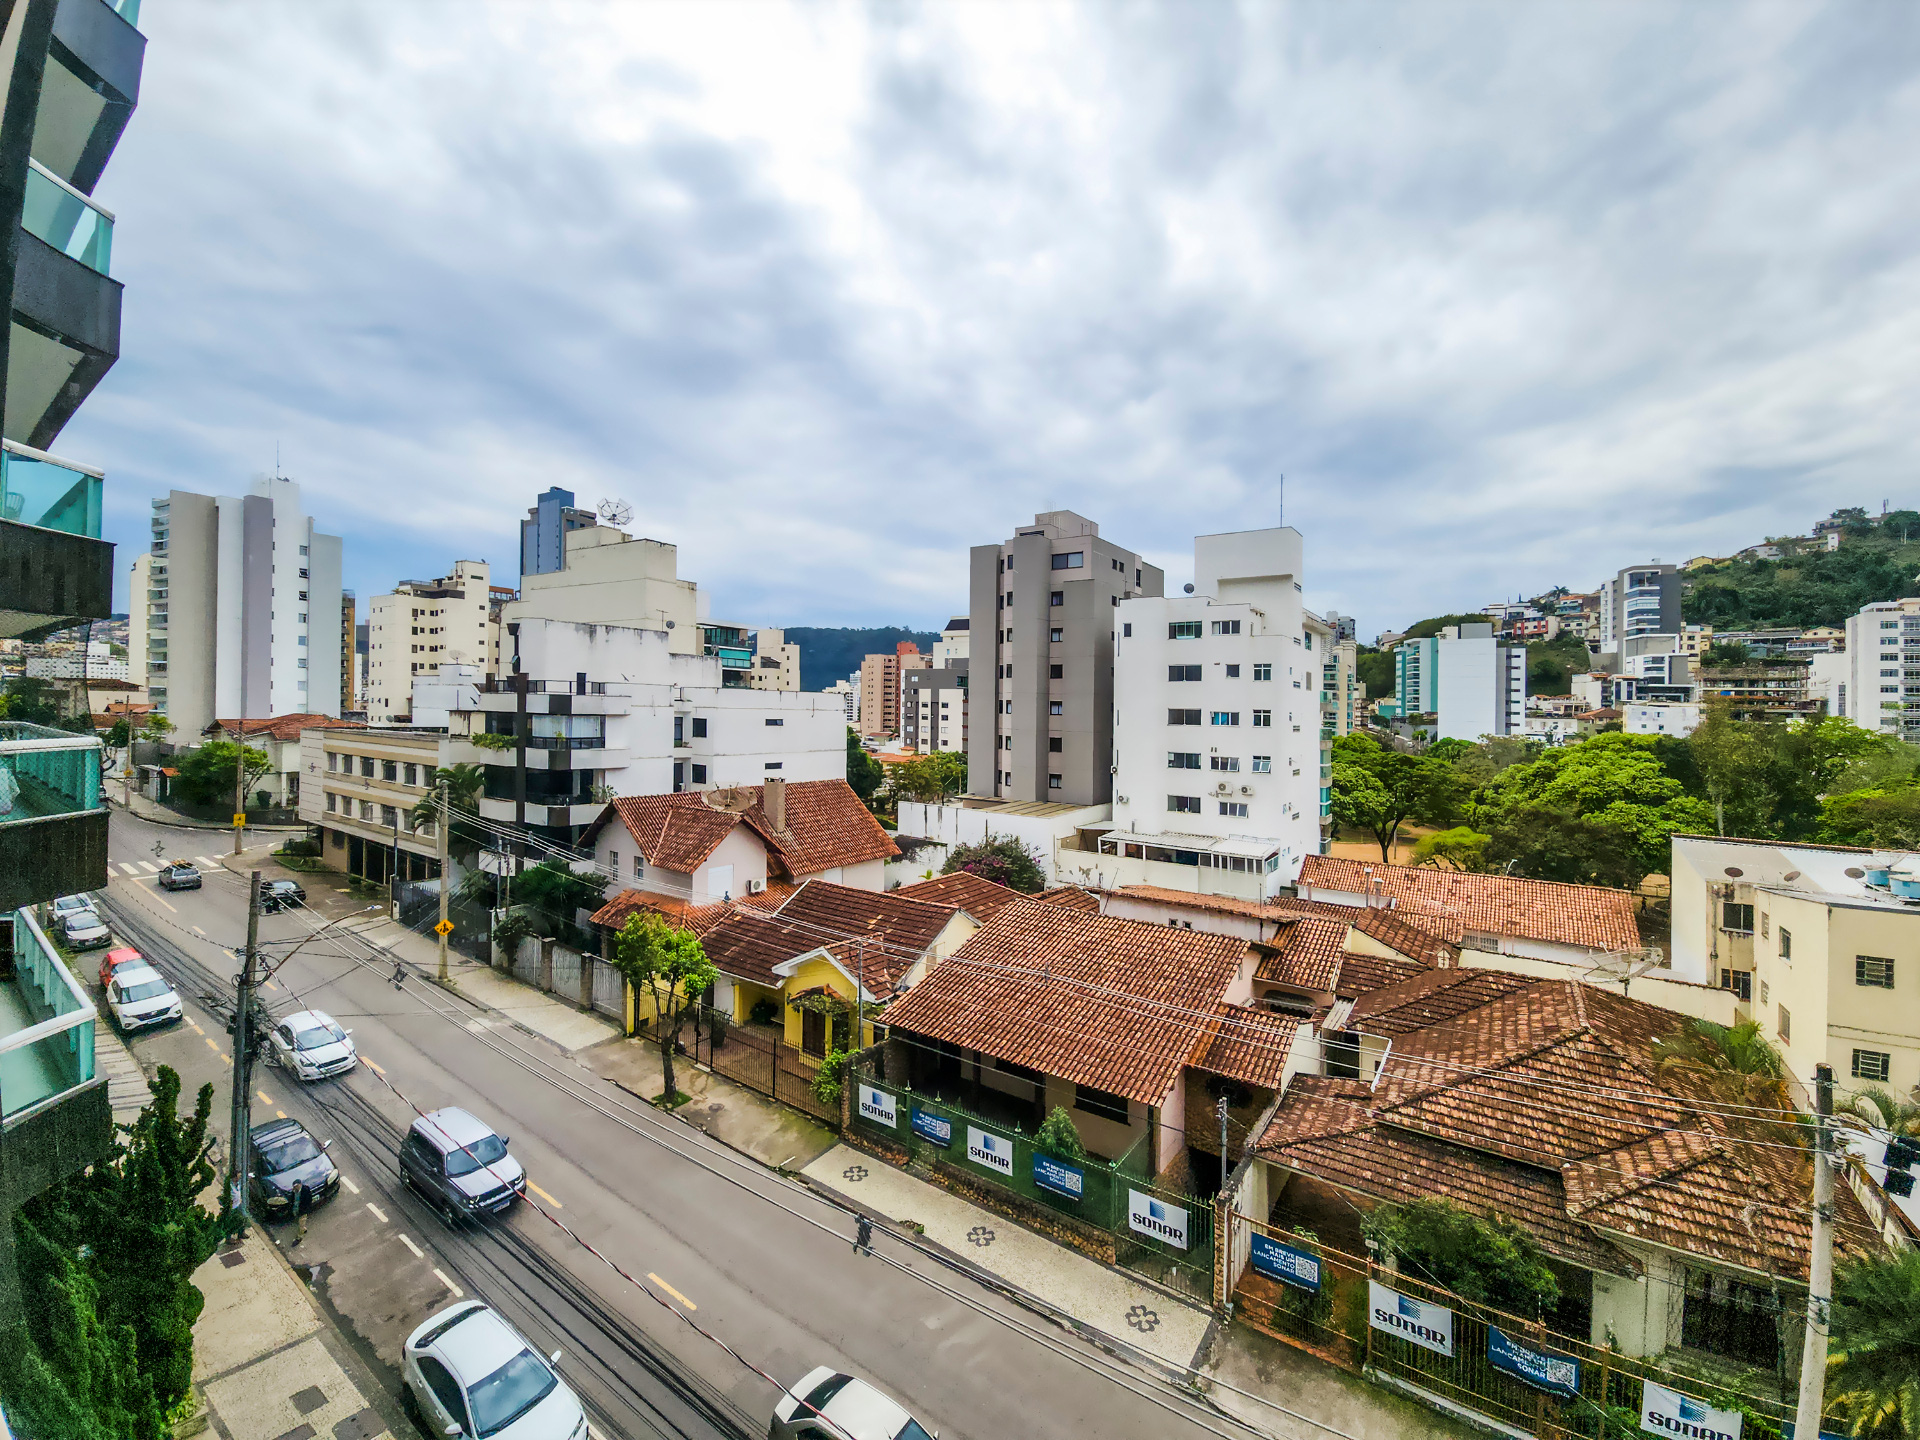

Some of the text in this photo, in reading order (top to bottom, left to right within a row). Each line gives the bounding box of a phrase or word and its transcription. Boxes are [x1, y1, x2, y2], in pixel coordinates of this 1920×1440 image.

[861, 1102, 894, 1122] SONAR
[970, 1146, 1009, 1169] SONAR
[1132, 1212, 1183, 1242] SONAR
[1264, 1243, 1295, 1259] EM BREVE
[1269, 1250, 1295, 1264] MAIS UM
[1272, 1261, 1295, 1275] SONAR
[1374, 1308, 1446, 1347] SONAR
[1517, 1361, 1547, 1379] SONAR
